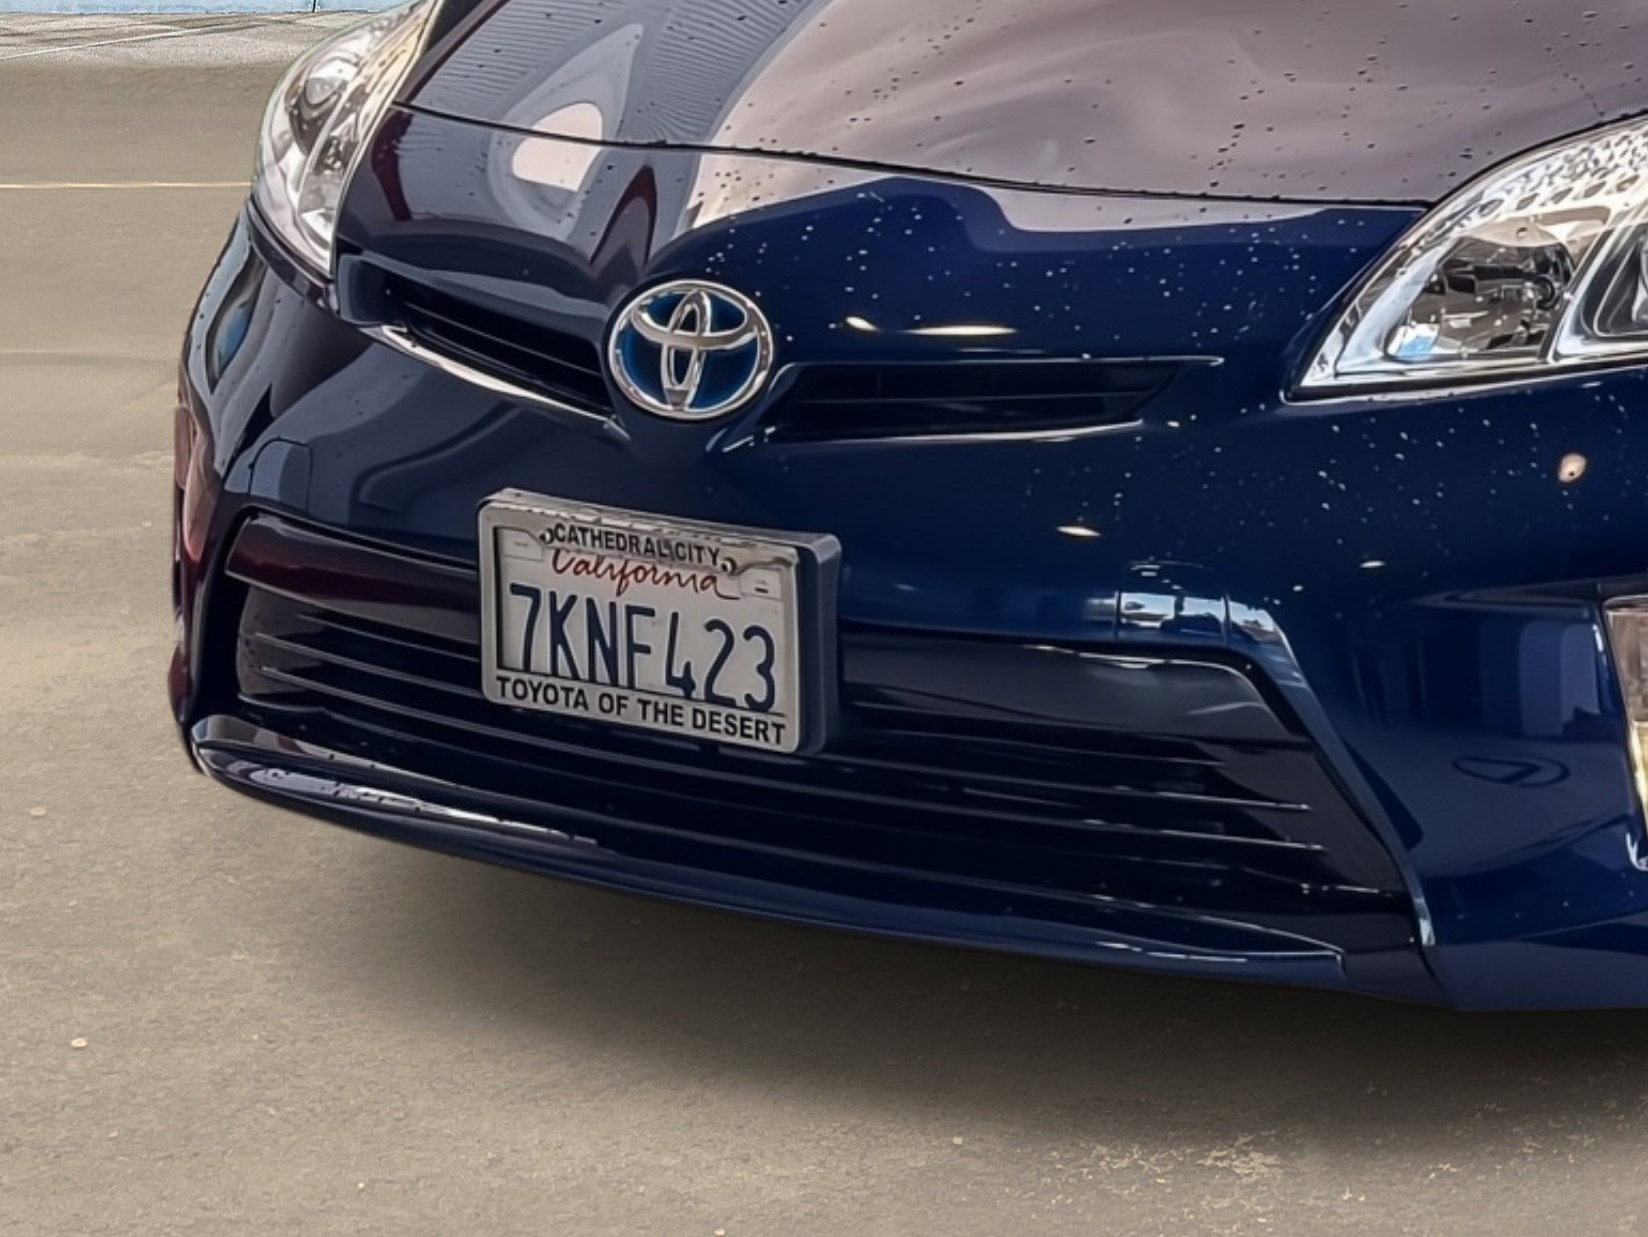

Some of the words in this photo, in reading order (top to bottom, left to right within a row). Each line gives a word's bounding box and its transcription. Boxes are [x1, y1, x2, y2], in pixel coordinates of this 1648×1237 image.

[551, 548, 741, 601] California
[553, 522, 667, 559] CATHEDRAL
[675, 540, 720, 566] CITY
[509, 582, 776, 712] 7KNF423
[496, 675, 589, 711] TOYOTA
[598, 692, 630, 716] OF
[637, 697, 685, 726] THE
[691, 707, 786, 745] DESERT
